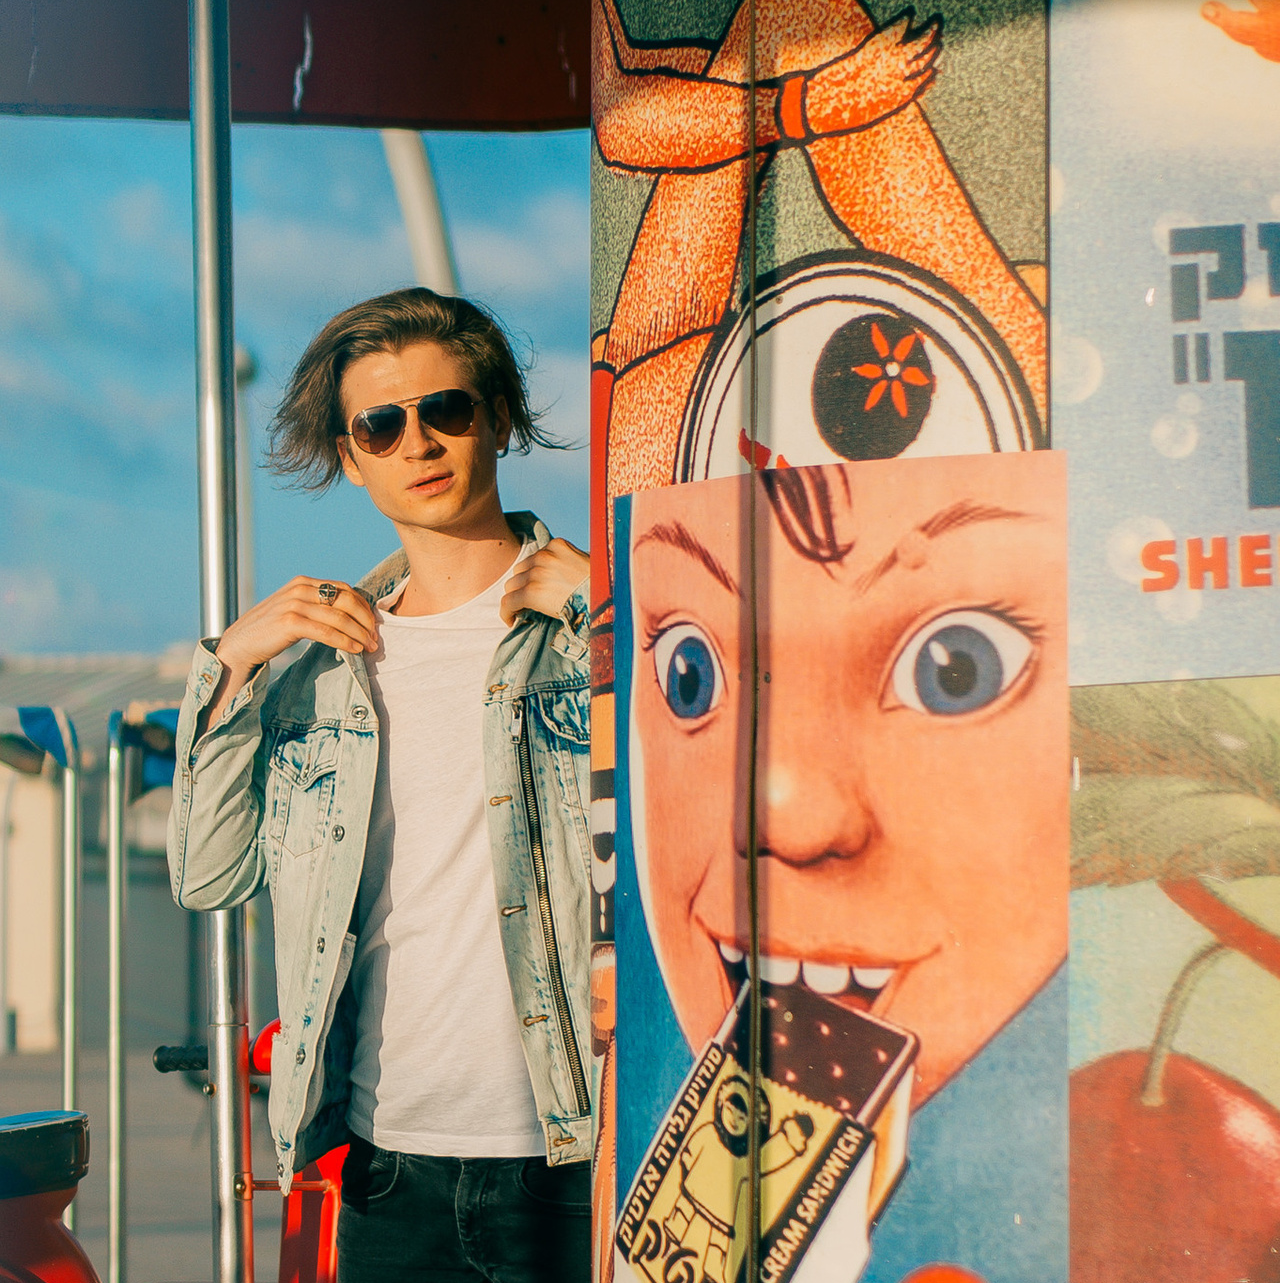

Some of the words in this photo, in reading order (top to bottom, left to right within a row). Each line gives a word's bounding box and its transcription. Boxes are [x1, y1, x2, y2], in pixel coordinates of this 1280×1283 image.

[1141, 534, 1280, 593] SHE
[654, 1104, 692, 1166] גלידה
[619, 1163, 661, 1248] ארטיק
[795, 1125, 864, 1225] SANDWICH
